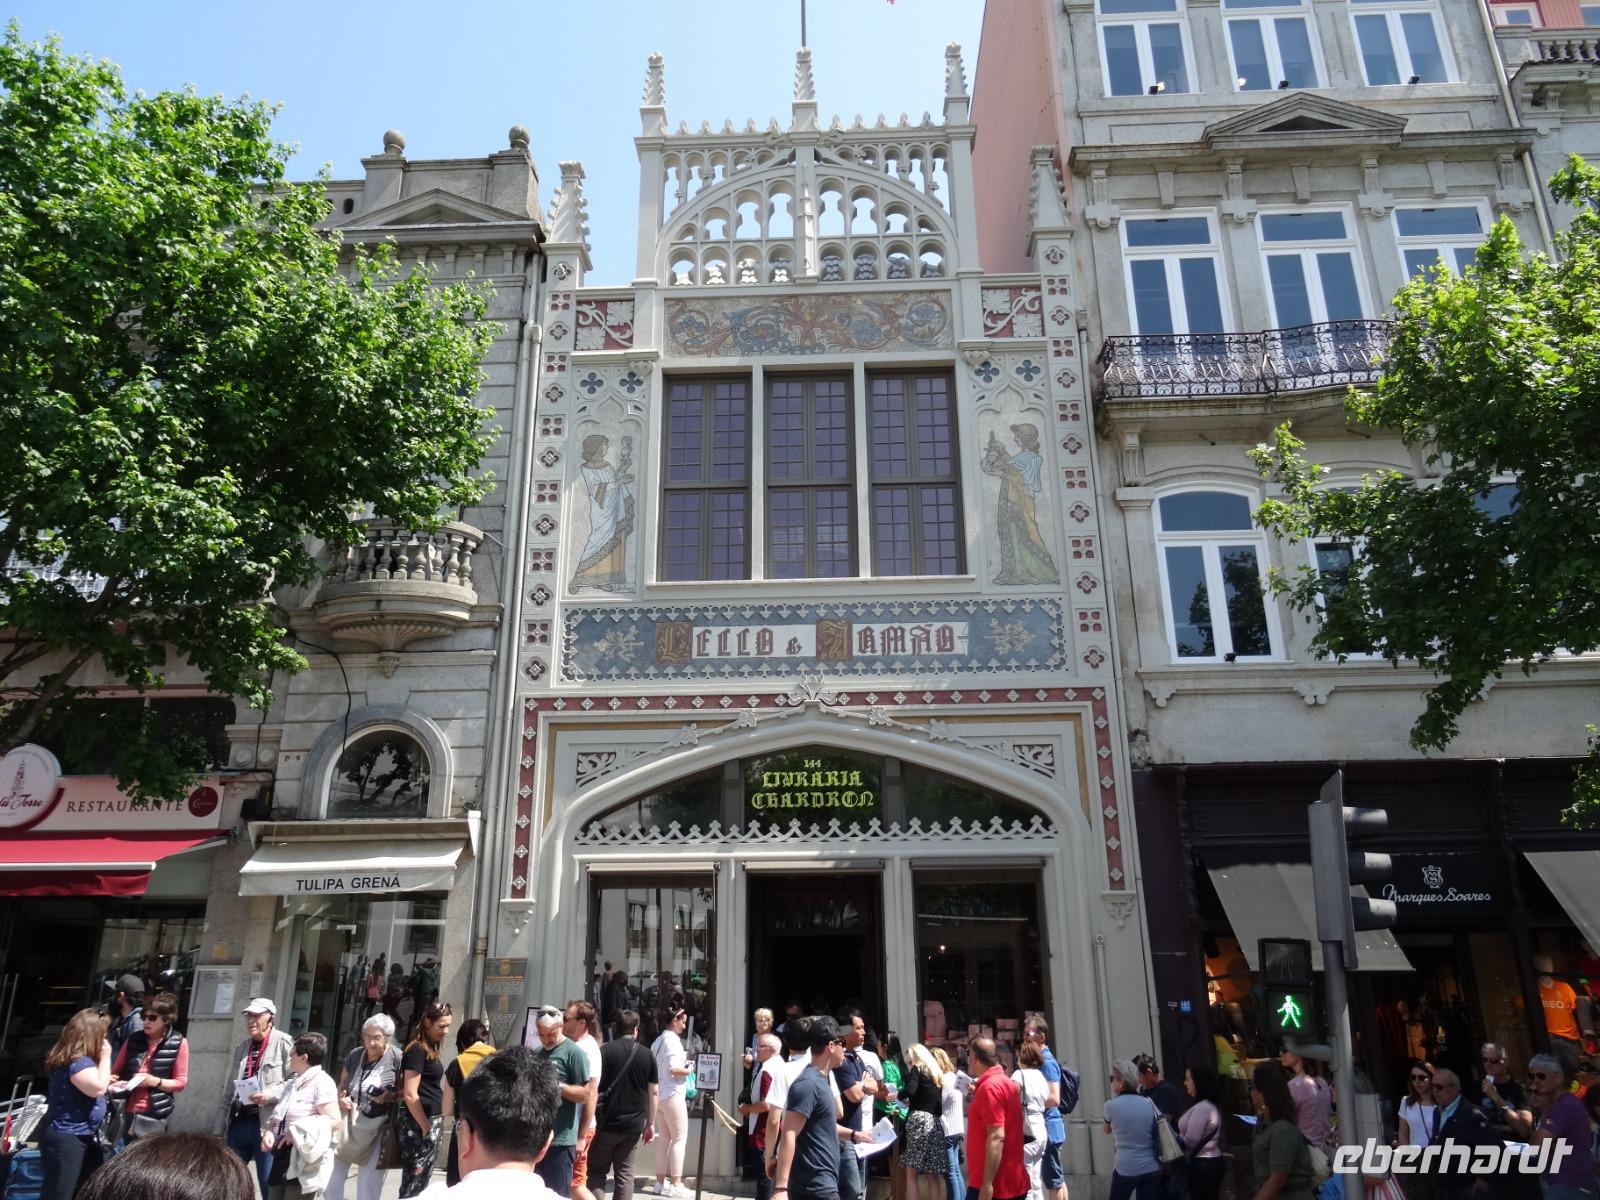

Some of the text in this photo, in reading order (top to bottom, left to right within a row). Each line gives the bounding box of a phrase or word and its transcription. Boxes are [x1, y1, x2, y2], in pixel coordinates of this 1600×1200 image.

[785, 636, 803, 655] &
[804, 759, 822, 768] 144
[762, 770, 863, 787] LIVRARIA
[66, 799, 183, 812] RESTAURANTE
[752, 790, 874, 809] CHARDRON
[296, 873, 400, 891] TULIPA GRENÁ
[1382, 883, 1491, 905] Marques Soares
